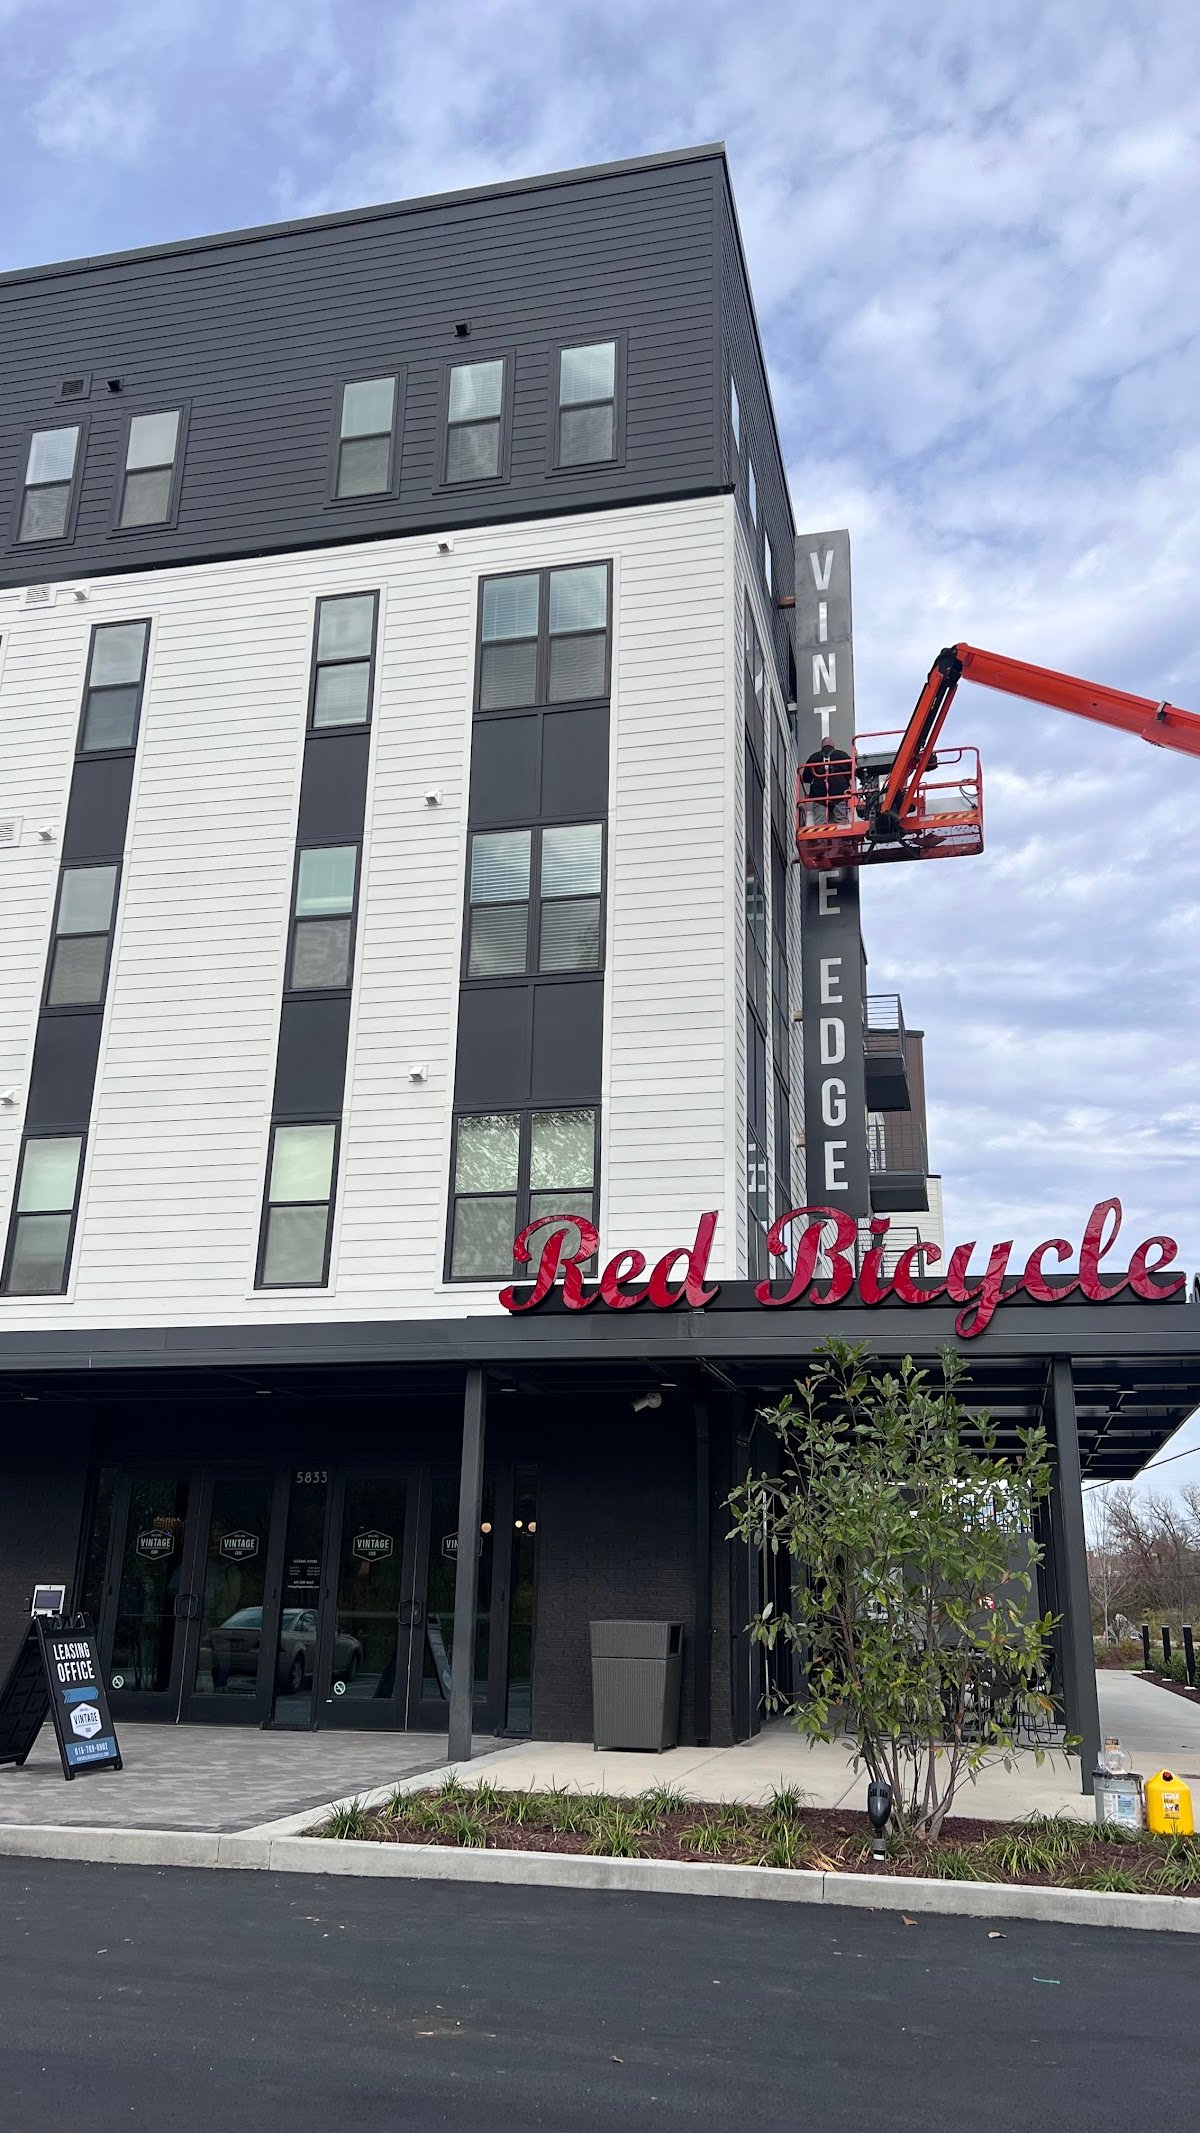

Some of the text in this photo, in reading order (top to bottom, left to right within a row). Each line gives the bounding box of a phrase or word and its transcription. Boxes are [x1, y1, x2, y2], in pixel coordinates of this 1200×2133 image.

[809, 549, 849, 1190] VINTE EDGE
[499, 1197, 1186, 1339] Red Bicycle
[296, 1471, 328, 1484] 5833
[140, 1538, 171, 1547] VINTAGE
[224, 1539, 255, 1548] VINTAGE
[357, 1539, 389, 1548] VINTAGE
[53, 1642, 91, 1660] LEASING
[57, 1660, 95, 1683] OFFICE
[73, 1712, 98, 1725] VINTAGE
